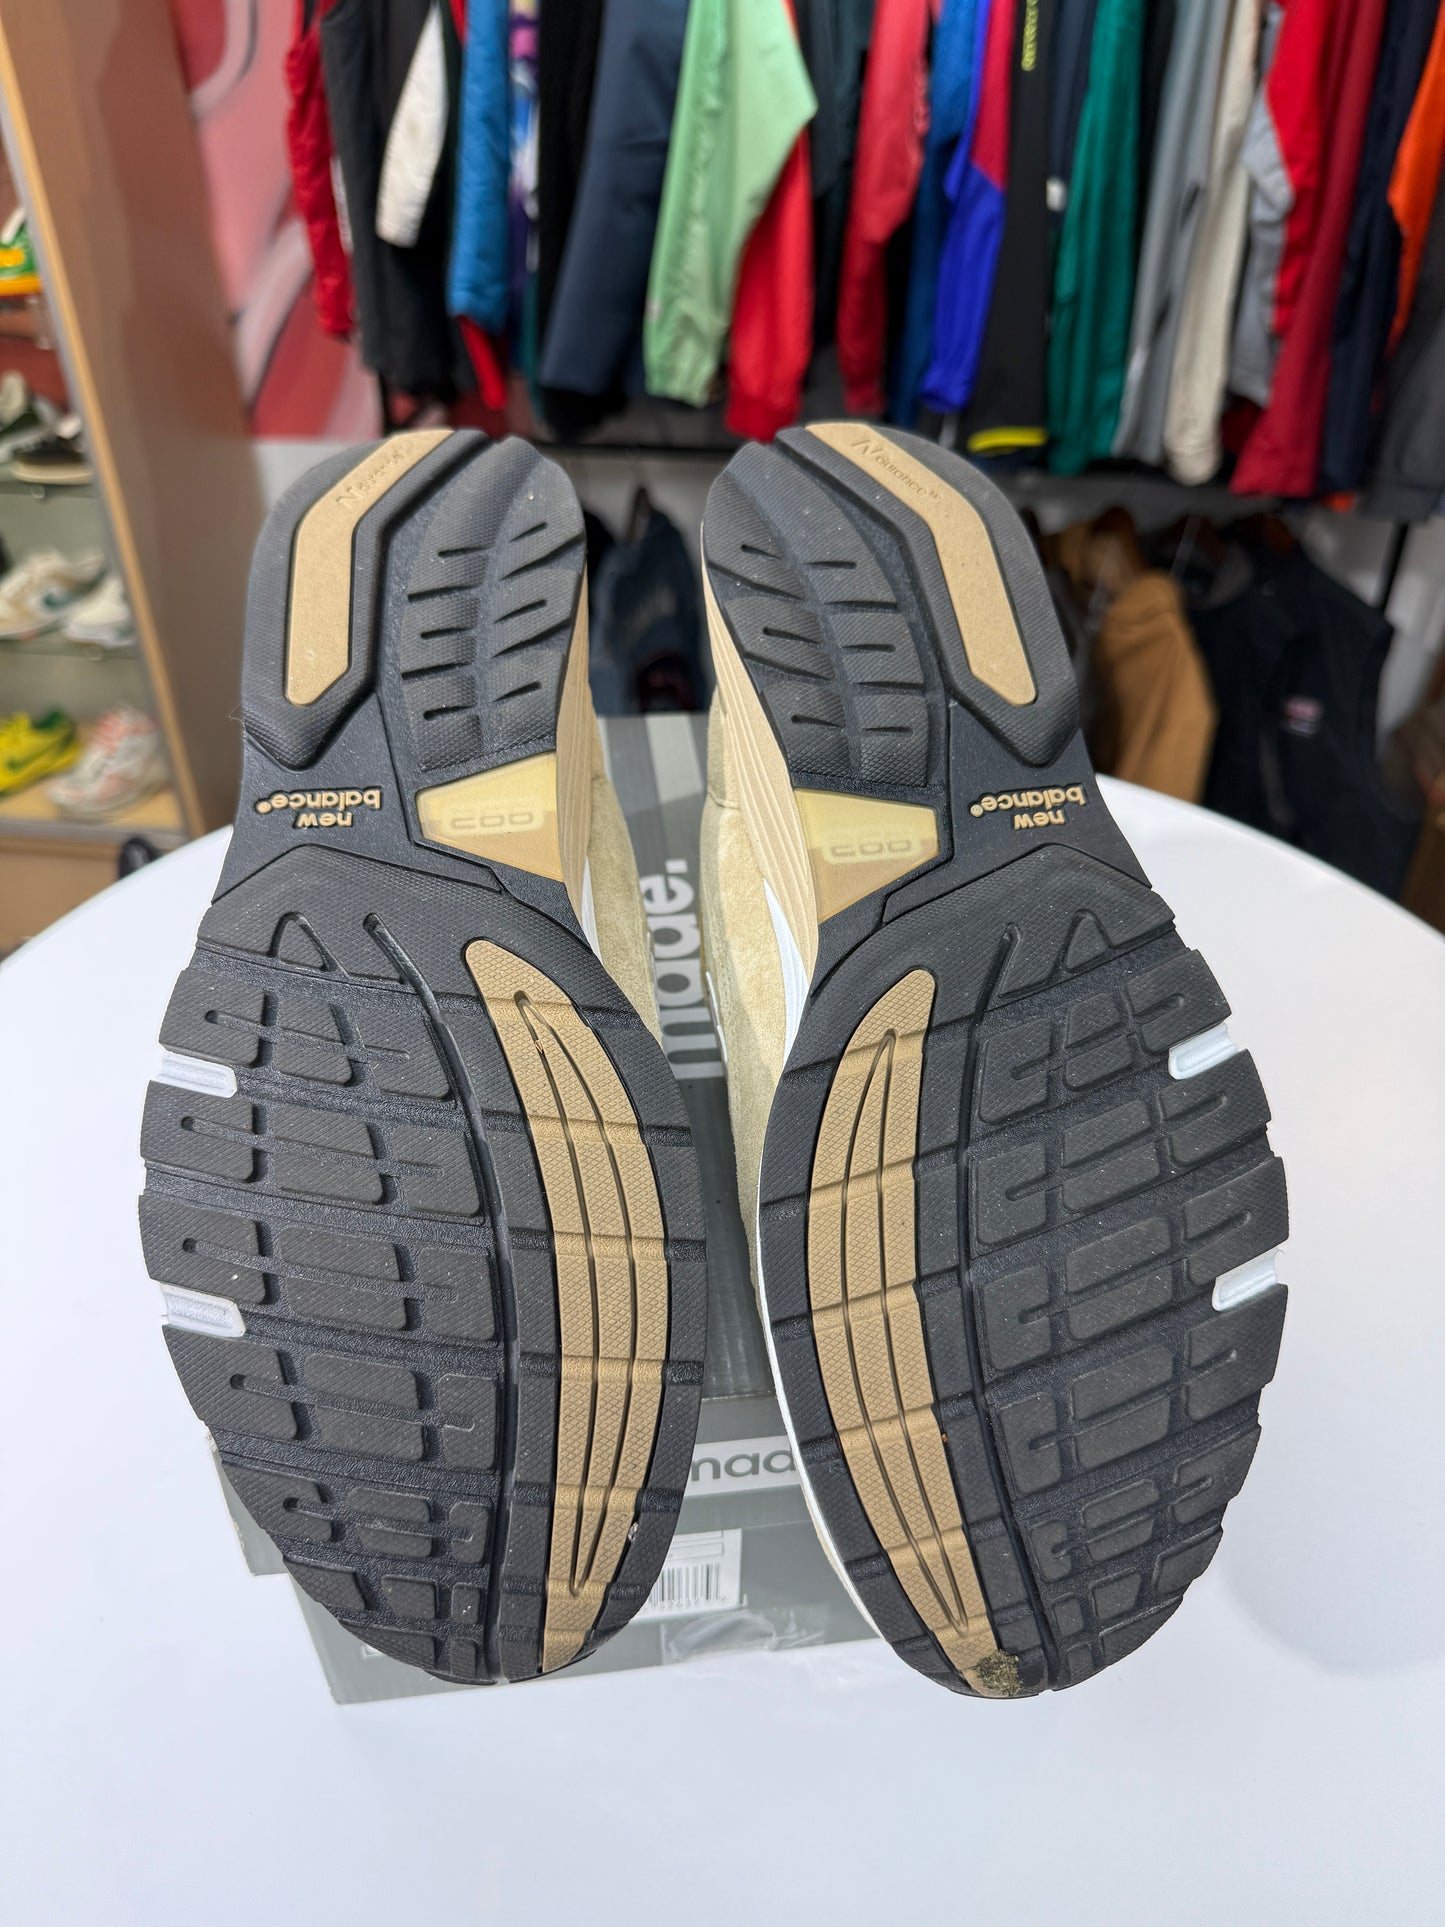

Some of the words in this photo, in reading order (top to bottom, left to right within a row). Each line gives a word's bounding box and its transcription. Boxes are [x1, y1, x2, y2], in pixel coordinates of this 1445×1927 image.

[297, 811, 352, 828] new
[1014, 809, 1065, 830] new
[690, 1448, 797, 1482] mad
